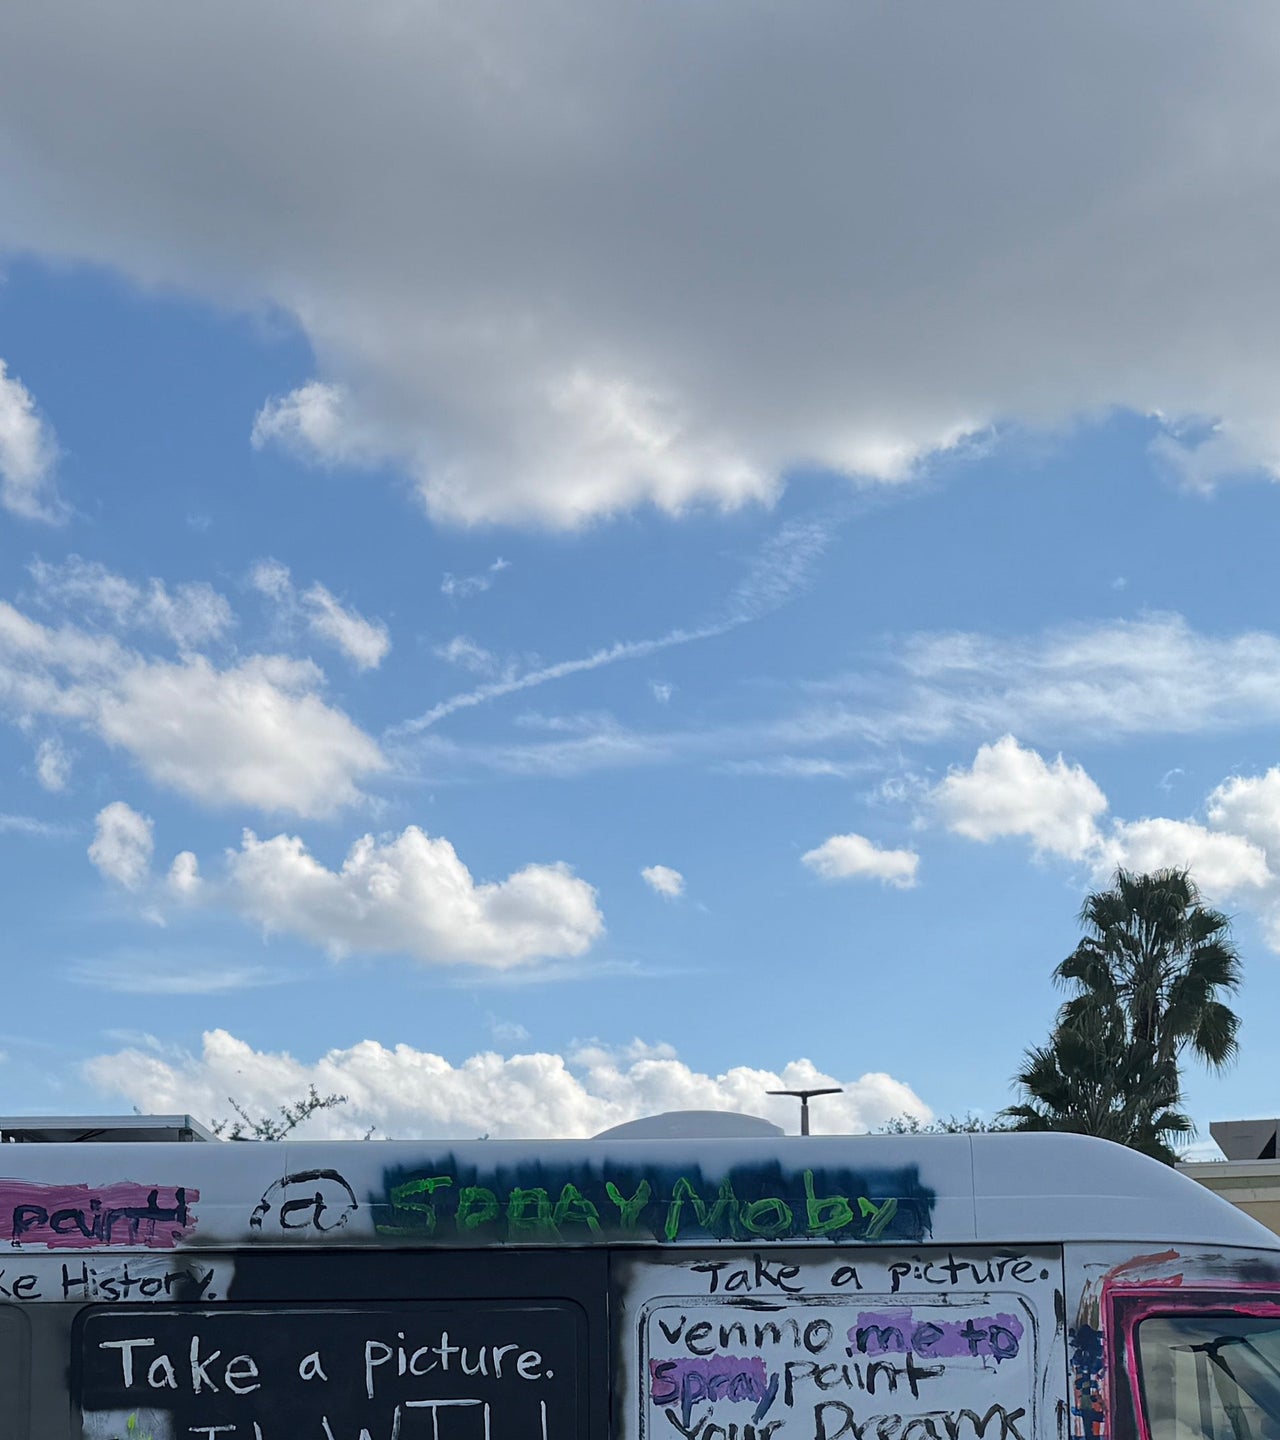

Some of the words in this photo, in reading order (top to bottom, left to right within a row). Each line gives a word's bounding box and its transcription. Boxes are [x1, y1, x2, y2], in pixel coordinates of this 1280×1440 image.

[250, 1168, 358, 1232] @
[61, 1262, 218, 1302] History.
[691, 1253, 805, 1293] Take
[831, 1264, 864, 1290] a
[888, 1252, 1050, 1293] picture.
[99, 1335, 261, 1395] Take
[299, 1351, 328, 1382] a
[365, 1331, 554, 1399] picture.
[855, 1321, 944, 1352] me
[960, 1318, 1020, 1365] to
